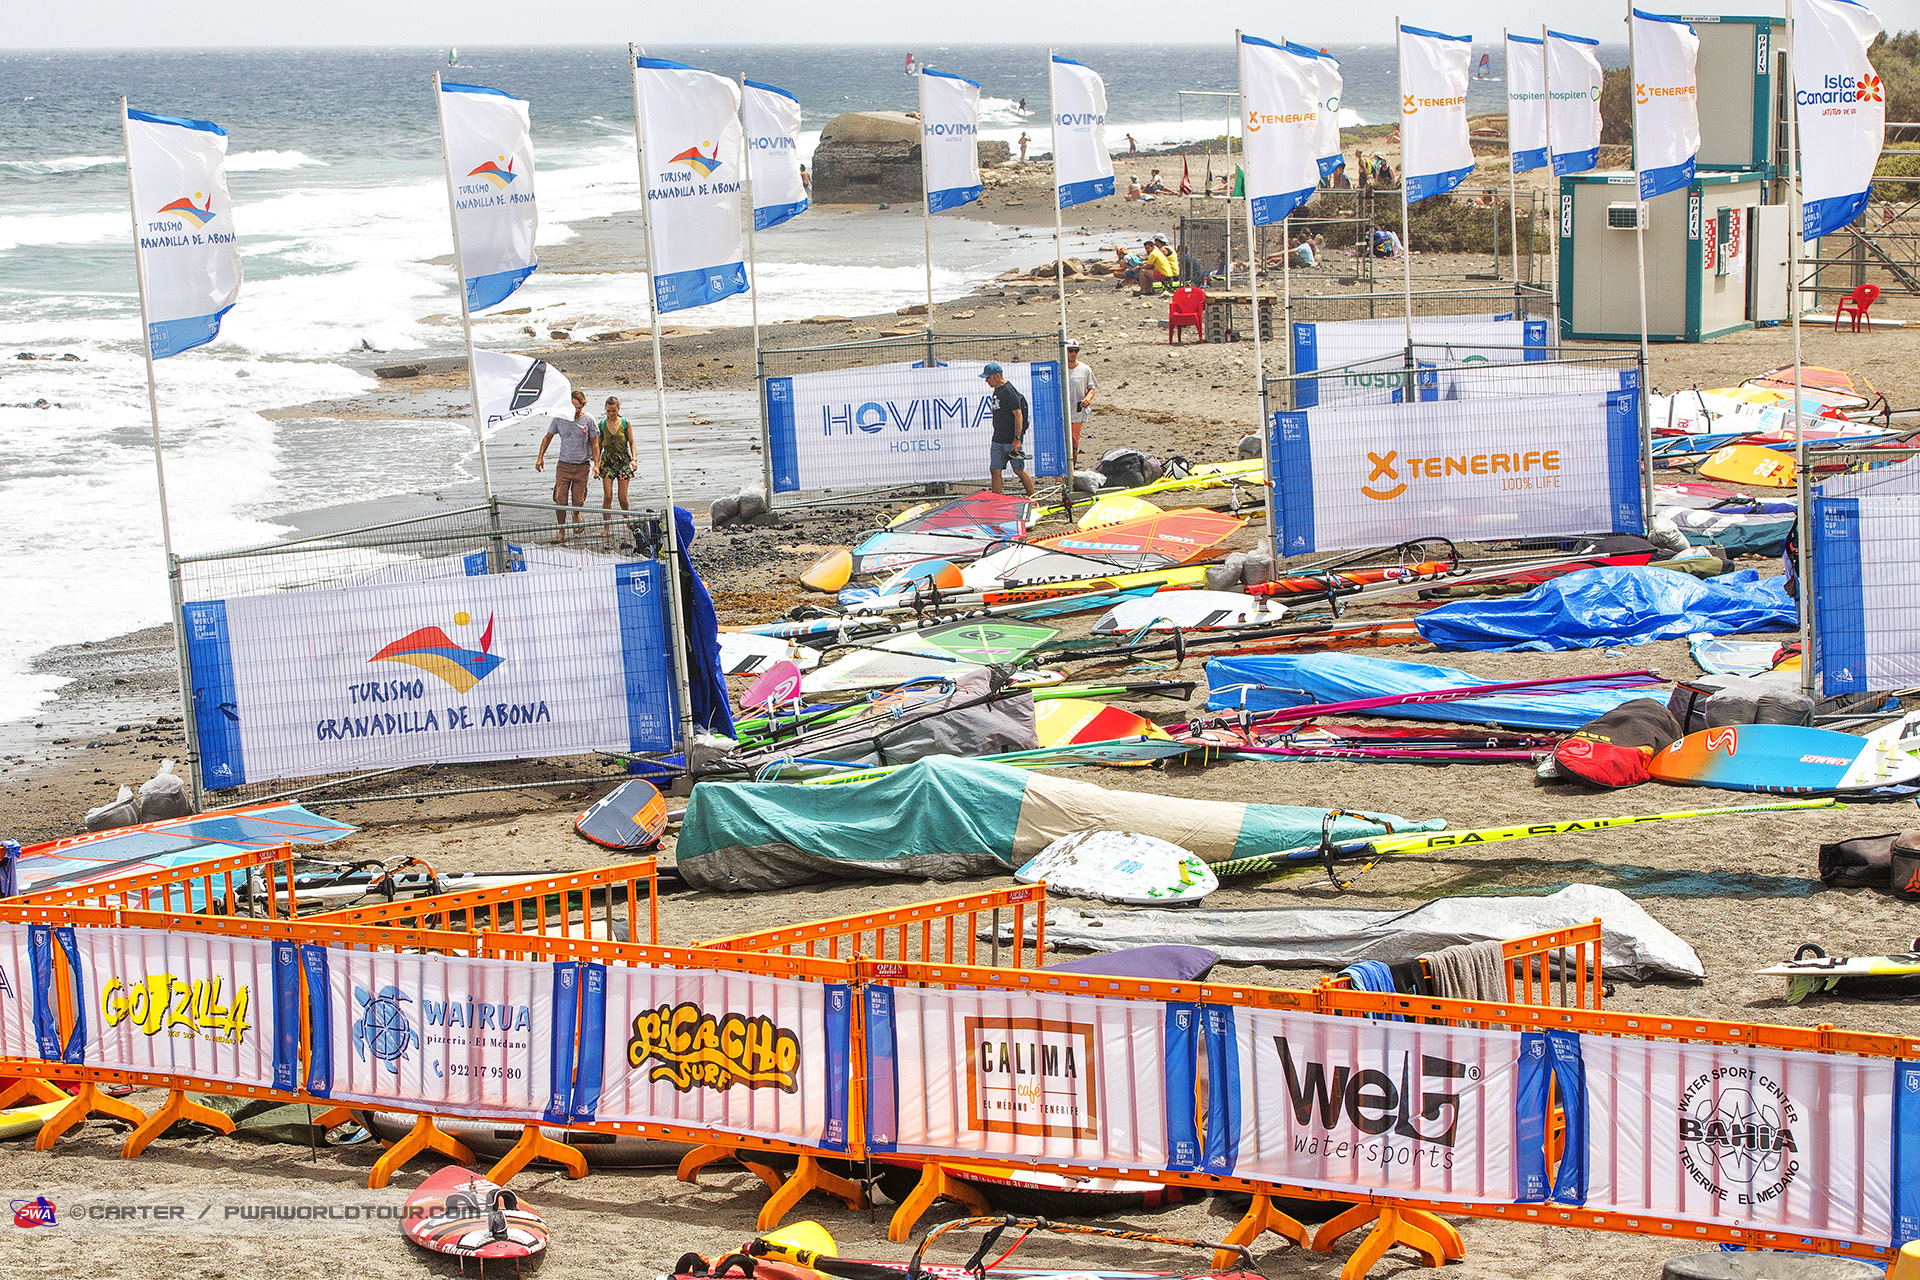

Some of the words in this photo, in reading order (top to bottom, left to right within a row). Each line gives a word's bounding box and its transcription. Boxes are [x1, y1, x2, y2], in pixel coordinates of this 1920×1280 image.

[1824, 74, 1856, 90] Islas
[1549, 90, 1588, 102] hospiten
[1648, 85, 1696, 96] TENERIFE
[1796, 89, 1857, 105] Canarias
[1054, 113, 1105, 126] HOVIMA
[1260, 112, 1318, 124] TENERIFE
[925, 124, 978, 136] HOVIMA
[660, 171, 692, 183] TURISMO
[459, 183, 490, 195] TURISMO
[648, 185, 696, 200] GRANADILLA
[699, 183, 710, 196] DE
[712, 182, 741, 194] ABONA
[496, 194, 507, 206] DE
[510, 192, 536, 204] ABONA
[1562, 197, 1570, 234] OPEIN
[1690, 198, 1699, 236] OPEIN
[148, 220, 183, 232] TURISMO
[192, 234, 205, 245] DE
[208, 232, 237, 244] ABONA
[823, 396, 994, 436] HOVIMA
[890, 438, 942, 453] HOTELS
[1406, 450, 1560, 479] TENERIFE
[1501, 477, 1533, 491] 100%
[1535, 474, 1561, 489] LIFE
[1825, 514, 1846, 522] WORLD
[1825, 521, 1837, 530] CUP
[194, 617, 215, 627] WORLD
[348, 678, 424, 704] TURISMO
[316, 708, 440, 741] GRANADILLA
[447, 706, 475, 730] DE
[481, 700, 551, 727] ABONA
[427, 1034, 467, 1046] pizzeria
[475, 1037, 486, 1047] El
[490, 1037, 528, 1049] Médano
[981, 1041, 1078, 1079] CALIMA
[450, 1063, 471, 1077] 922
[473, 1065, 489, 1078] 17
[491, 1066, 504, 1078] 95
[506, 1067, 522, 1080] 80
[652, 1061, 732, 1090] SURF
[1017, 1077, 1042, 1105] café
[1677, 1073, 1711, 1113] WATER
[1711, 1066, 1757, 1081] SPORT
[1758, 1075, 1799, 1125] CENTER
[983, 1099, 993, 1109] EL
[996, 1098, 1028, 1112] MÉDANO
[1040, 1103, 1079, 1116] TENERIFE
[1679, 1117, 1799, 1153] BAHIA
[1294, 1135, 1455, 1170] watersports
[1678, 1146, 1729, 1201] TENERIFE
[1737, 1192, 1756, 1206] EL
[1755, 1159, 1800, 1204] MEDANO
